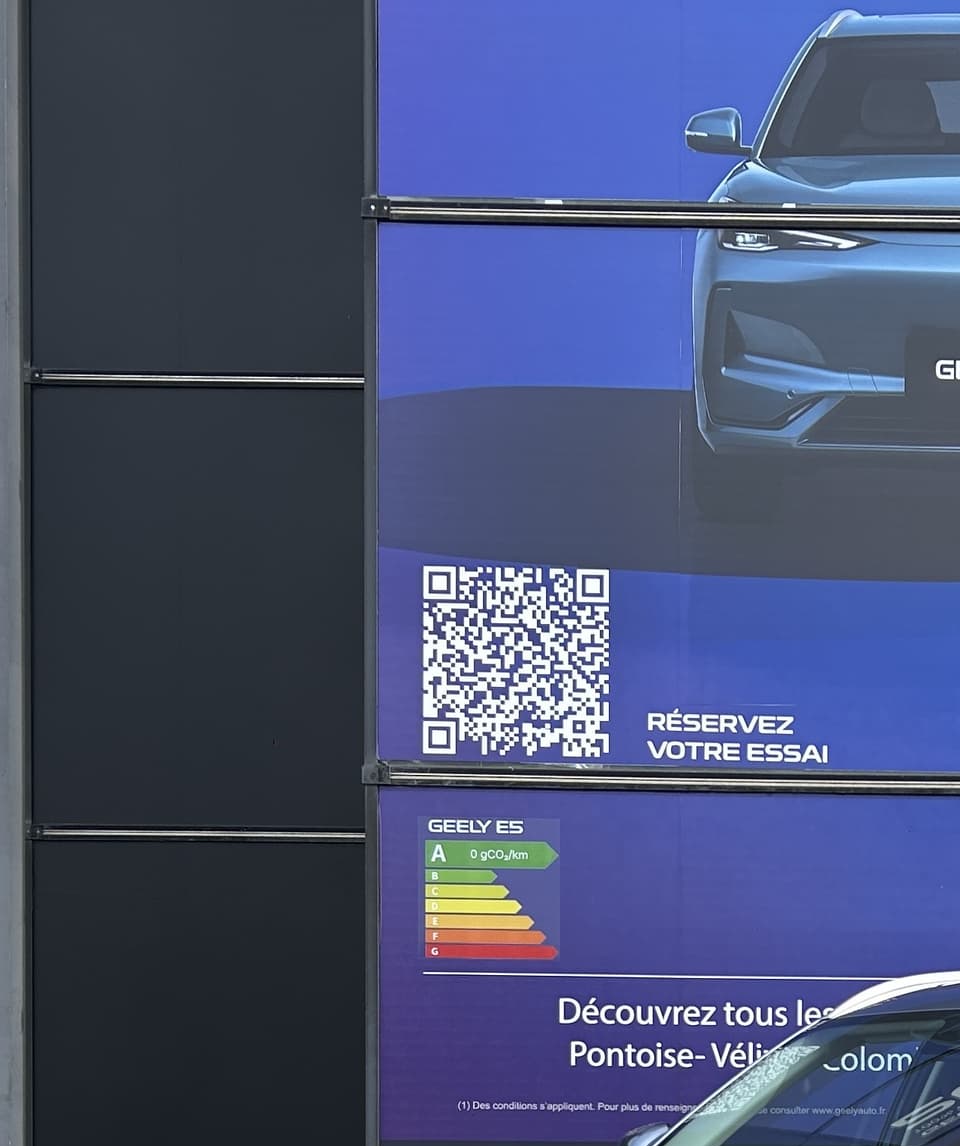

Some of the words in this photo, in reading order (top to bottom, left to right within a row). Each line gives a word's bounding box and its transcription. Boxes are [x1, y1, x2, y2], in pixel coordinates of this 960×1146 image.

[647, 708, 794, 735] RÉSERVEZ
[647, 741, 740, 761] VOTRE
[747, 743, 829, 763] ESSAI
[428, 819, 492, 834] GEELY
[496, 820, 524, 834] E5
[431, 844, 447, 862] A
[470, 849, 478, 859] 0
[431, 872, 439, 880] B
[431, 887, 439, 896] C
[431, 902, 439, 910] D
[432, 917, 439, 926] E
[432, 932, 439, 941] F
[431, 947, 439, 956] G
[559, 997, 717, 1026] Découvrez
[723, 1001, 788, 1027] tous
[570, 1041, 706, 1068] Pontoise-
[710, 1042, 769, 1068] Véli
[457, 1101, 471, 1111] (1)
[472, 1101, 491, 1110] Des
[492, 1101, 538, 1110] conditions
[597, 1102, 619, 1111] Pour
[621, 1103, 640, 1112] plus
[641, 1103, 653, 1111] de
[770, 1105, 809, 1115] consulter
